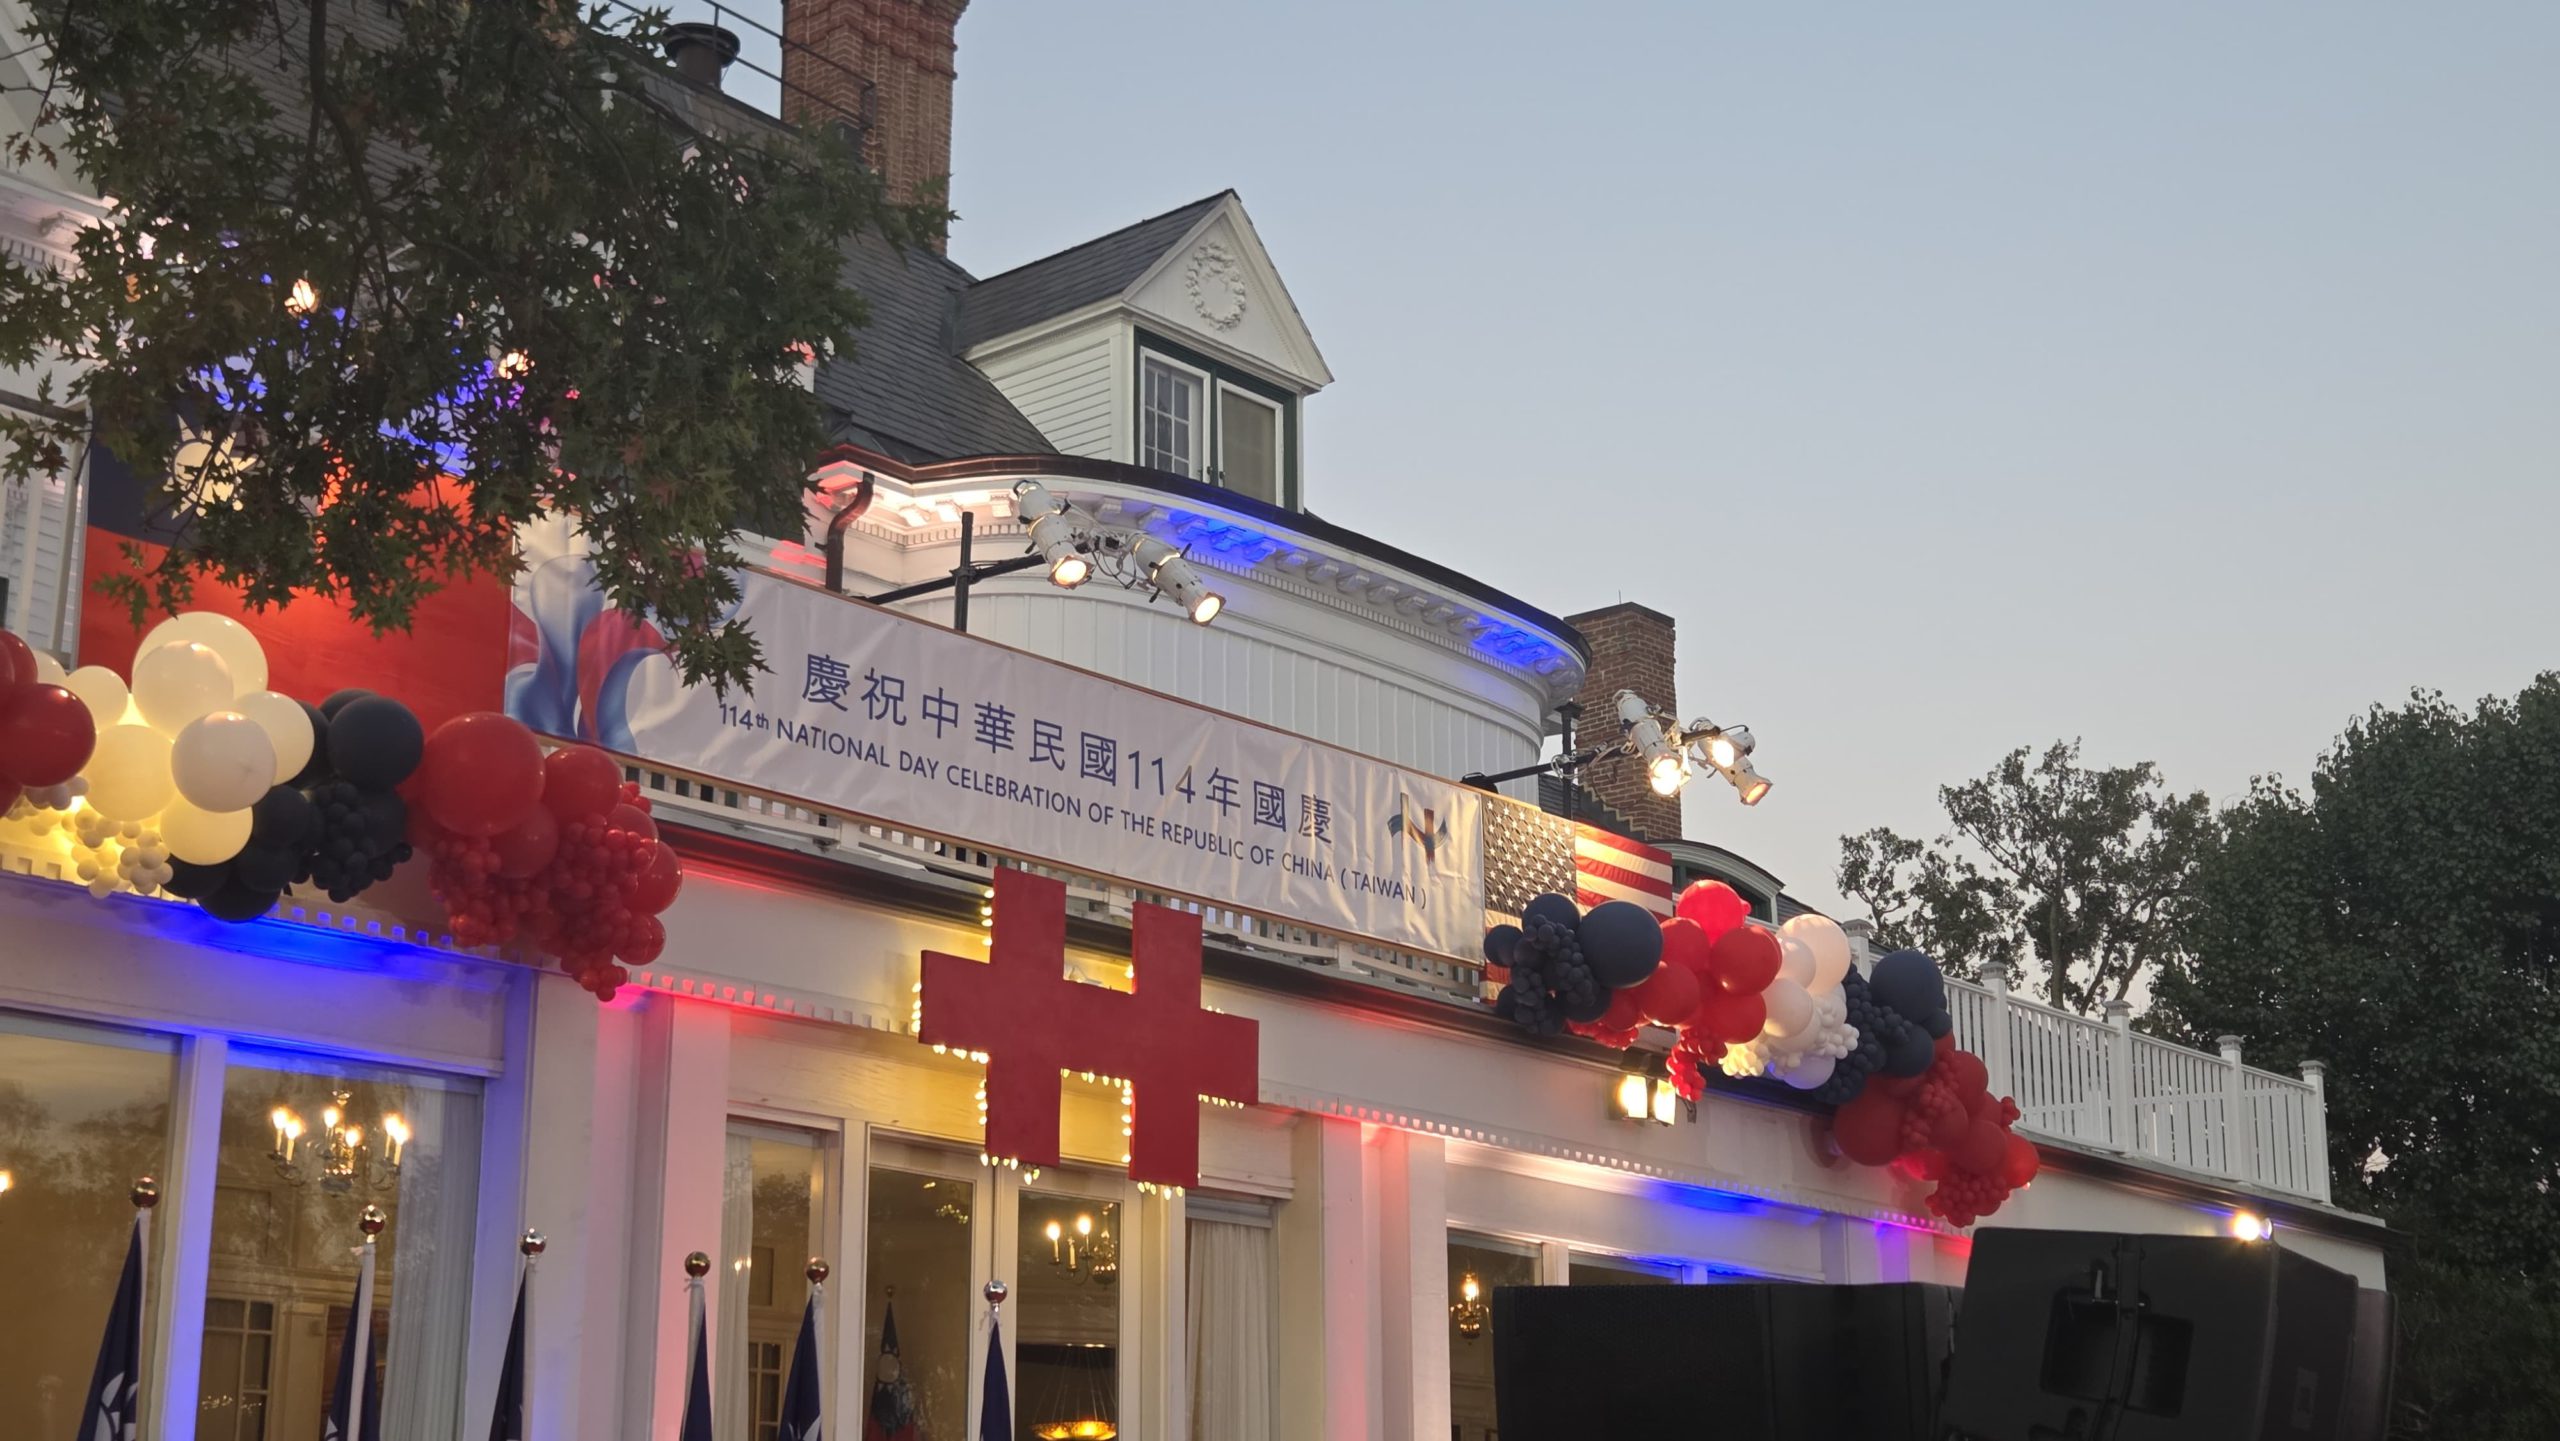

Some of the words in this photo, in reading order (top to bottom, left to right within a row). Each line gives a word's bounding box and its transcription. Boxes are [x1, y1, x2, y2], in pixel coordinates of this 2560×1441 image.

[718, 703, 770, 731] 114th
[776, 718, 891, 768] NATIONAL
[899, 750, 939, 780] DAY
[946, 765, 1081, 818] CELEBRATION
[1088, 802, 1114, 825] OF
[1120, 810, 1155, 837] THE
[1161, 821, 1244, 860] REPUBLIC
[1250, 845, 1275, 867] OF
[1281, 852, 1335, 883] CHINA
[802, 653, 1332, 845] 慶祝中華民國114年國慶
